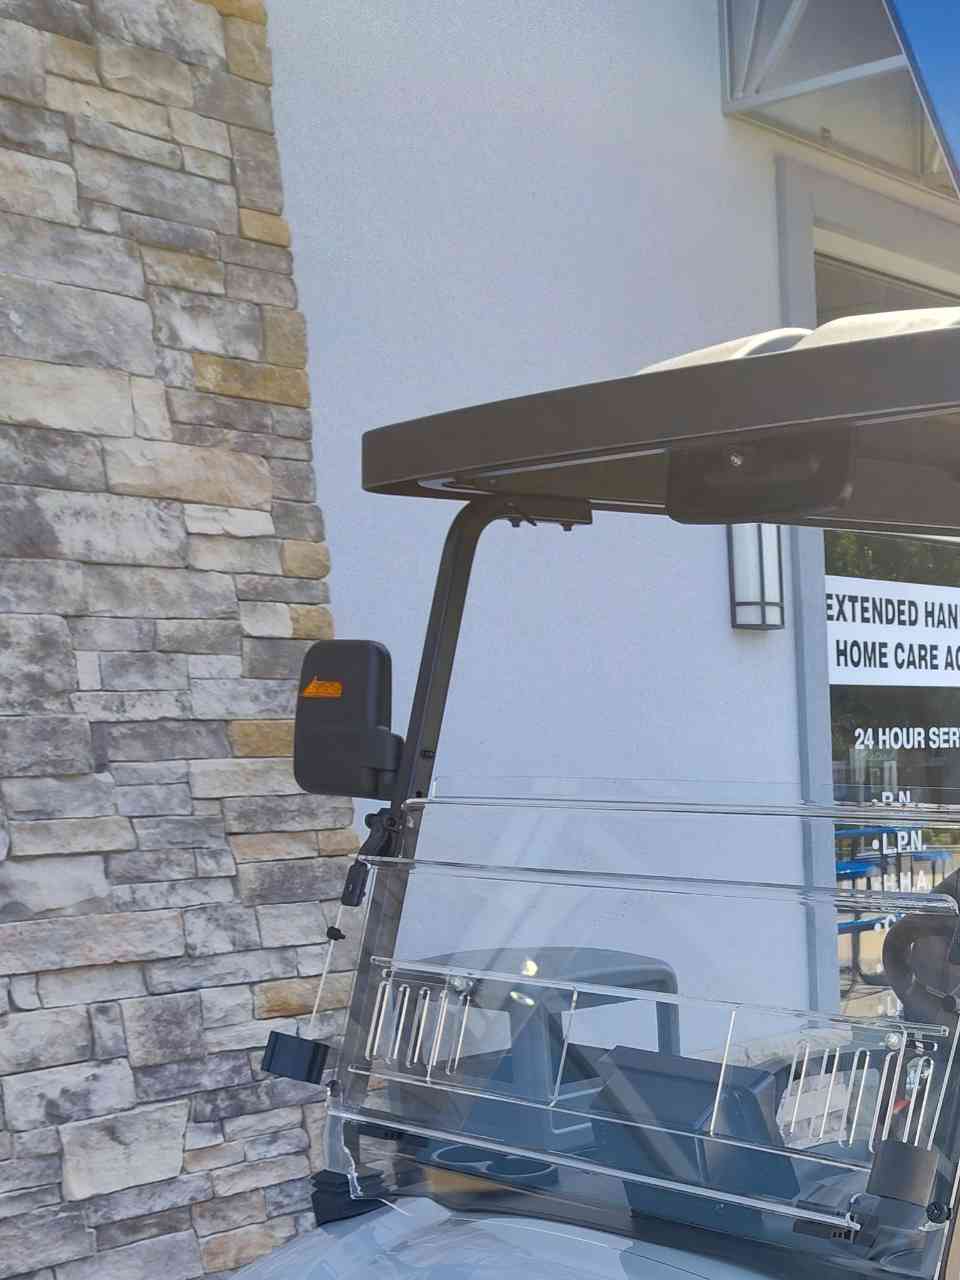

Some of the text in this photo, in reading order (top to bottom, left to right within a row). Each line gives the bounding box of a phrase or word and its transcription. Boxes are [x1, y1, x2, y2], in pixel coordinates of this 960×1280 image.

[825, 593, 919, 627] EXTENDED
[836, 639, 889, 668] HOME
[894, 641, 939, 670] CARE
[854, 727, 874, 749] 24
[878, 727, 925, 749] HOUR
